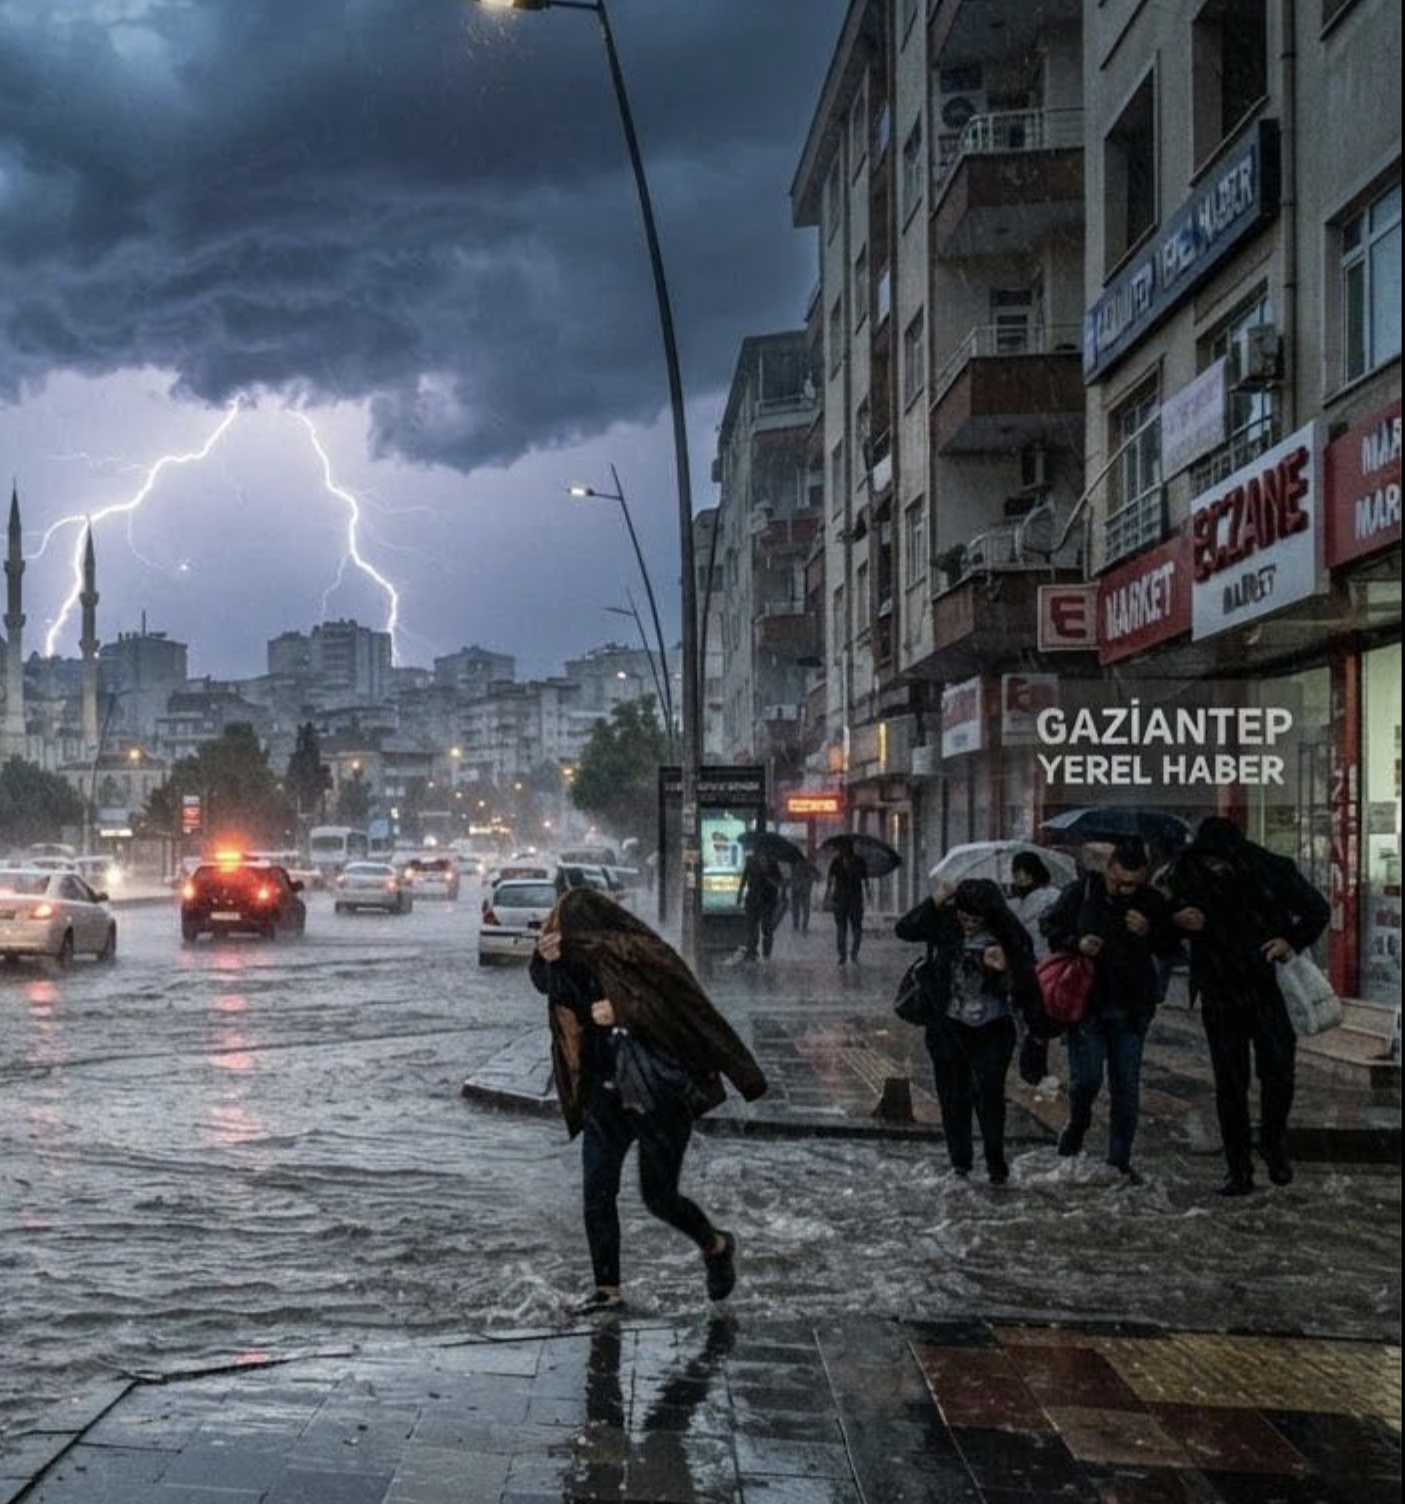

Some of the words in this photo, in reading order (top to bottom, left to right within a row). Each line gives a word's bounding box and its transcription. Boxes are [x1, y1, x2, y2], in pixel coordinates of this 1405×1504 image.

[1193, 446, 1310, 584] ECZANE
[1051, 596, 1087, 639] E
[1105, 560, 1175, 641] MARKET
